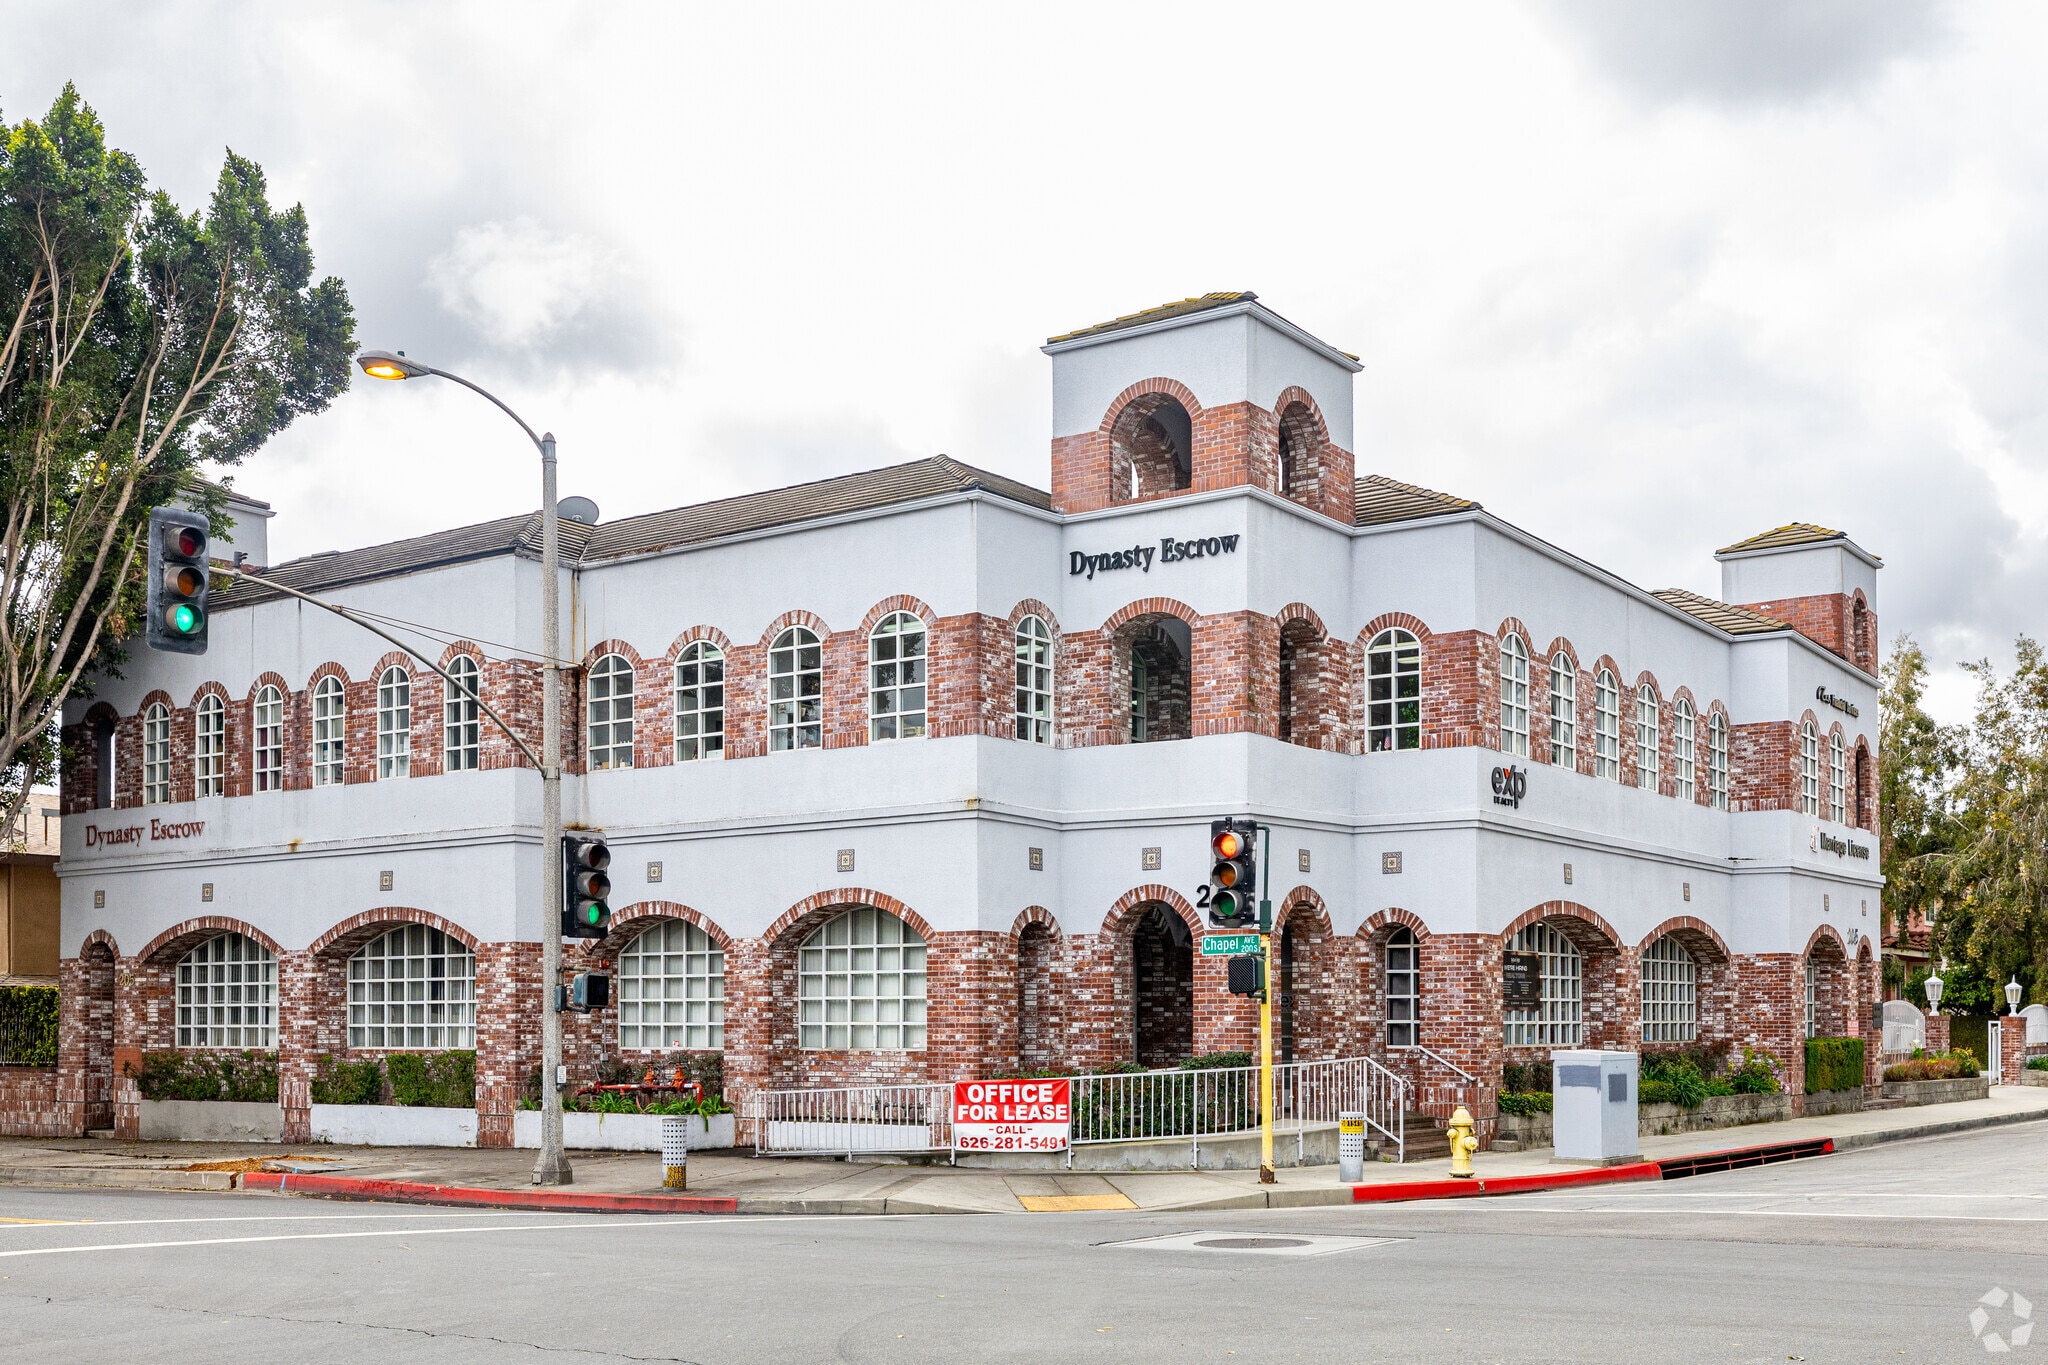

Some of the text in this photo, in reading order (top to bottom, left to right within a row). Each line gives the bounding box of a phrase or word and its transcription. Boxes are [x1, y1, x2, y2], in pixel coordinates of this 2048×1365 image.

[1069, 534, 1240, 580] Dynasty Escrow
[85, 818, 205, 851] Dynasty Escrow
[1820, 832, 1847, 859] Marriage
[1847, 839, 1870, 860] License
[1204, 936, 1255, 953] Chapel AVE
[119, 973, 135, 987] 205
[967, 1084, 1053, 1103] OFFICE
[957, 1104, 1068, 1121] FOR LEASE
[960, 1136, 1067, 1149] 626-281-5491
